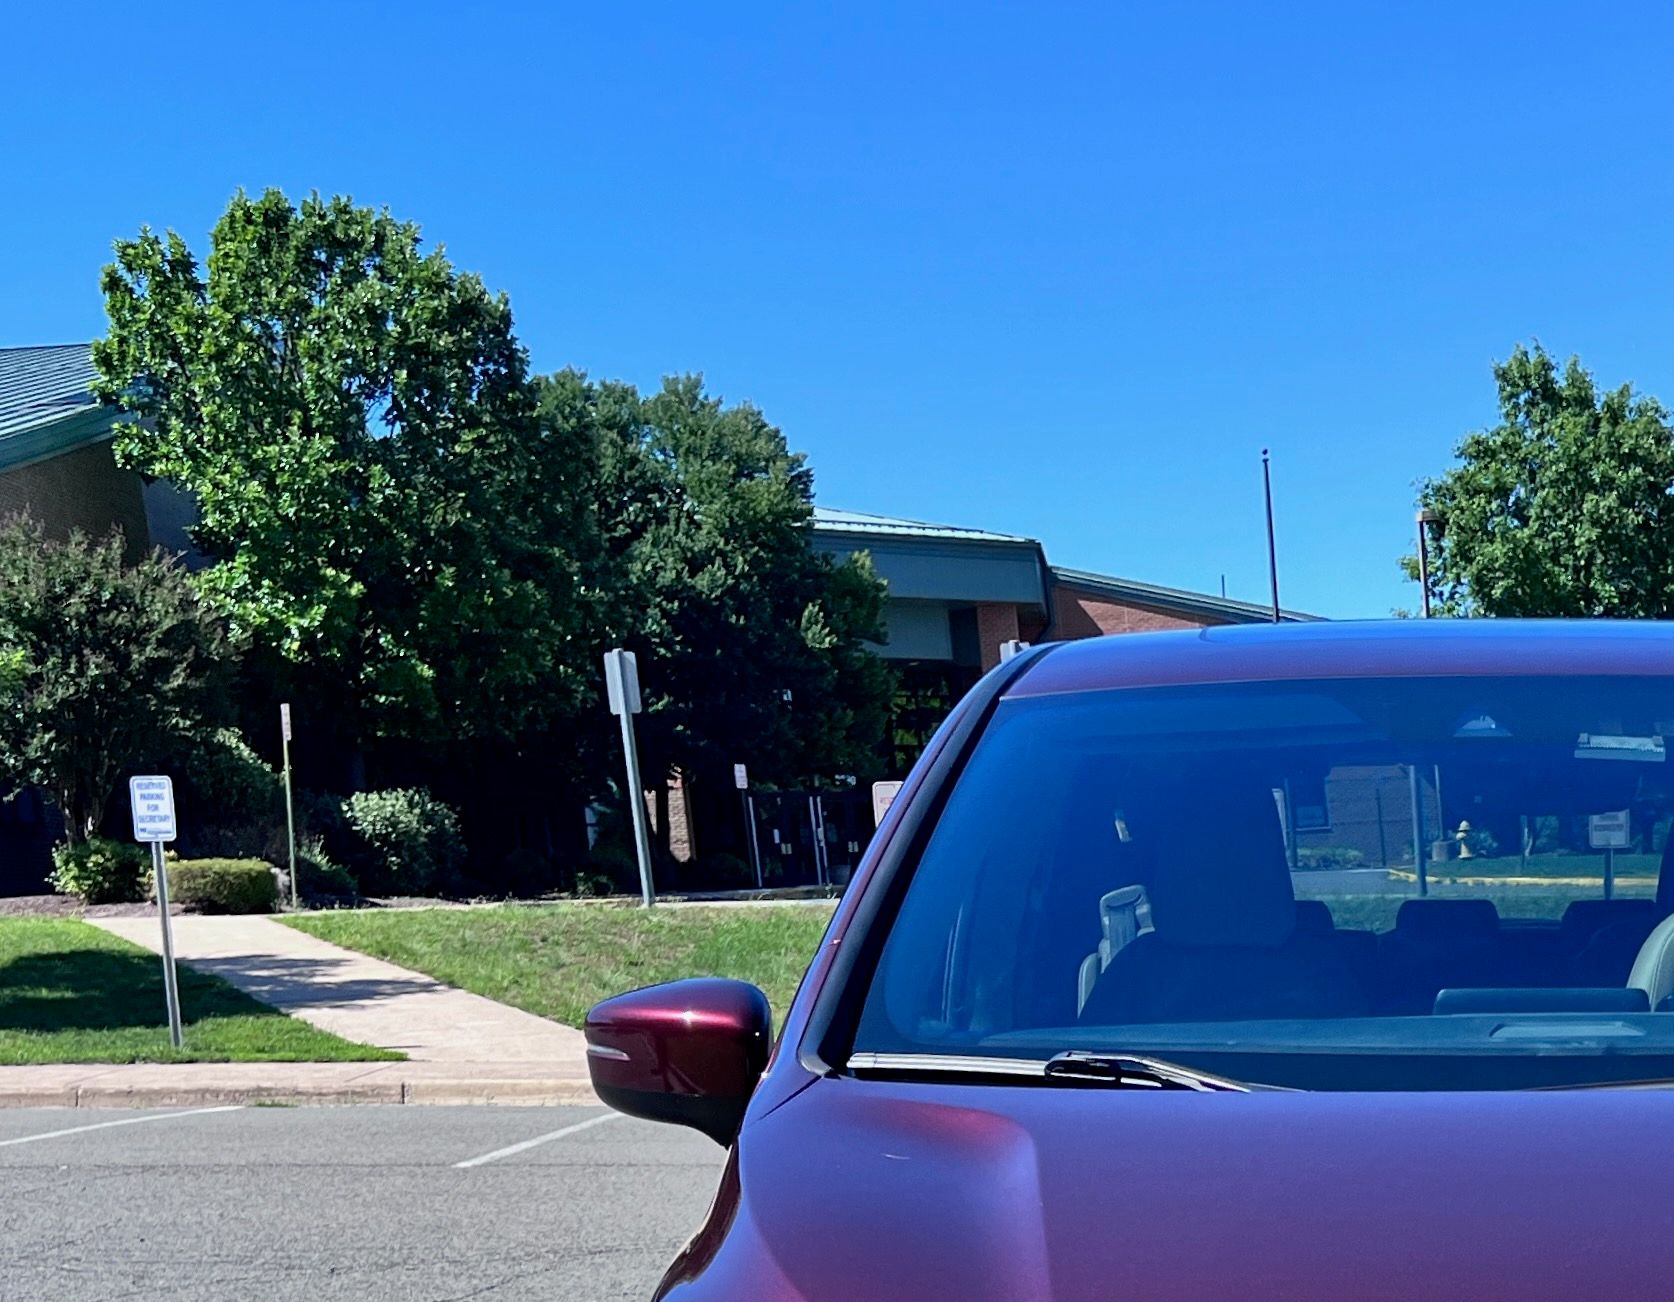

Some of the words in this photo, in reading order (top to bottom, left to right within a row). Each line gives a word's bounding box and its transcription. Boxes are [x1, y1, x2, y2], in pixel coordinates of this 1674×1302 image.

[140, 793, 165, 801] PARKING
[147, 804, 159, 812] FOR
[138, 815, 171, 823] SECRETARY
